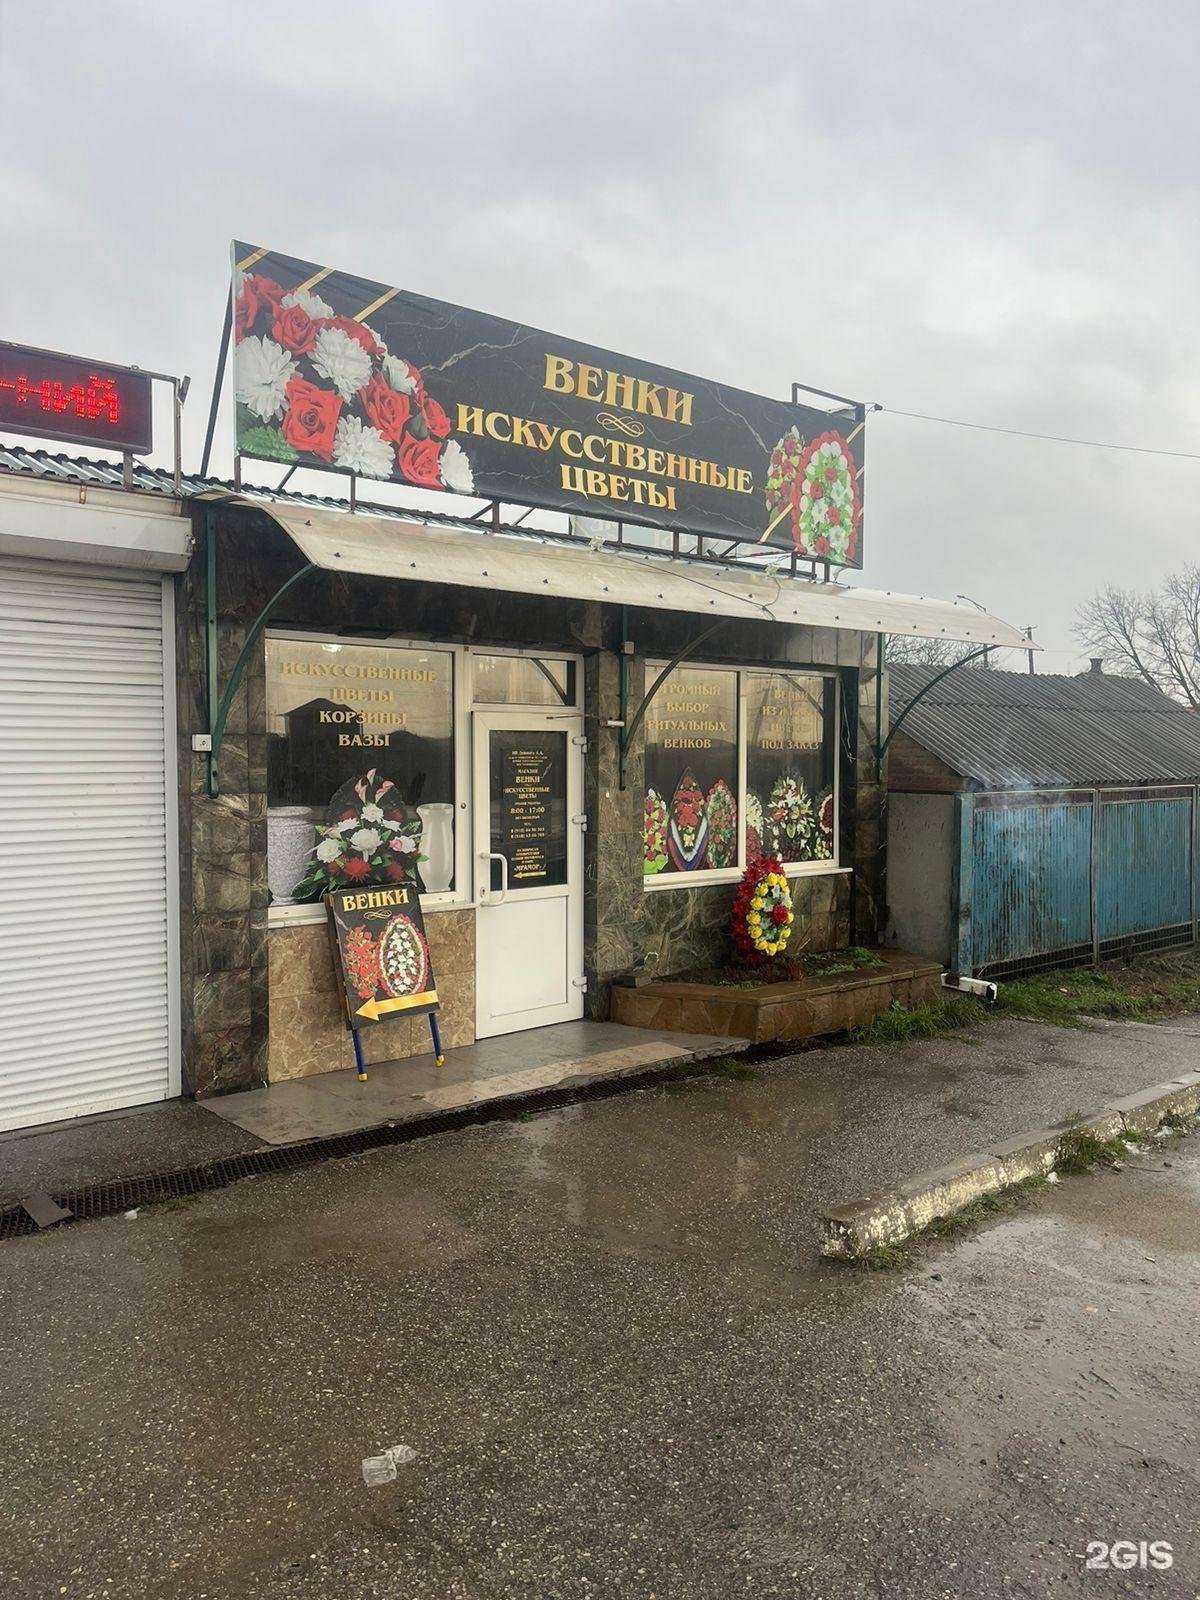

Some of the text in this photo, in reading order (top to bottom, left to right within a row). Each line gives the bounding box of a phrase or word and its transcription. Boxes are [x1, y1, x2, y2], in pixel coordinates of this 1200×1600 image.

[543, 353, 694, 426] ВЕНКИ
[456, 403, 755, 494] ИСКУССТВЕННЫЕ
[560, 464, 677, 512] ЦВЕТЫ
[281, 662, 438, 682] ИСКУССТВЕННЫЕ
[331, 687, 394, 703] ЦВЕТЫ
[666, 702, 709, 714] ВЫБОР
[319, 710, 407, 726] КОРЗИНЫ
[648, 719, 727, 732] РИТУАЛЬНЫХ
[337, 733, 391, 748] ВАЗЫ
[664, 738, 712, 750] ВЕНКОВ
[762, 739, 785, 751] ПОД
[342, 888, 409, 912] ВЕНКИ
